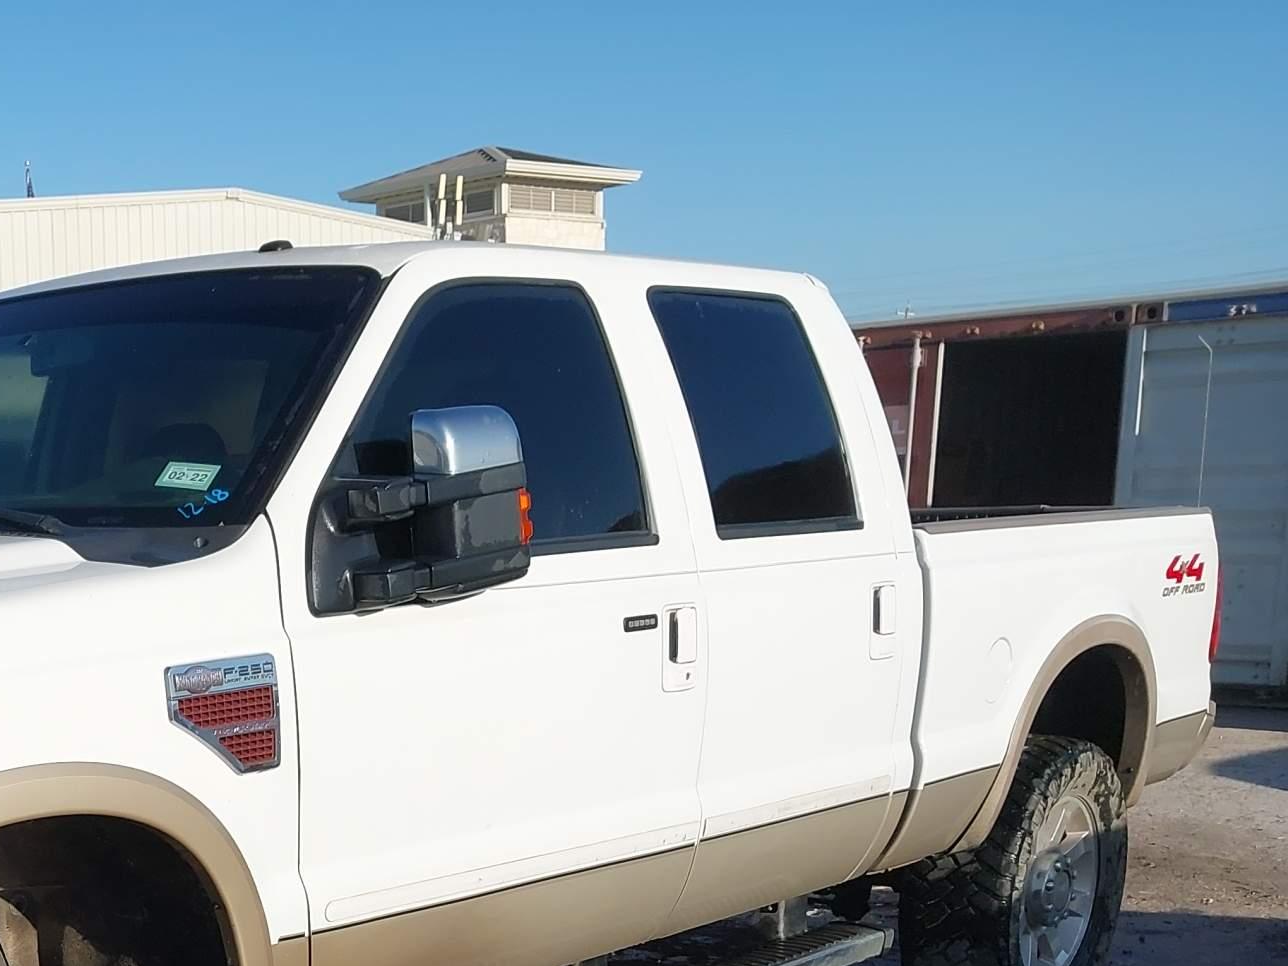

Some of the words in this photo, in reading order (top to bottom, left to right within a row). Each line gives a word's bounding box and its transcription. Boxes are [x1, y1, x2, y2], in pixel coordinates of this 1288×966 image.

[168, 471, 186, 481] 02
[191, 473, 208, 482] 22
[1162, 586, 1180, 597] OFF
[1181, 583, 1206, 594] ROAD
